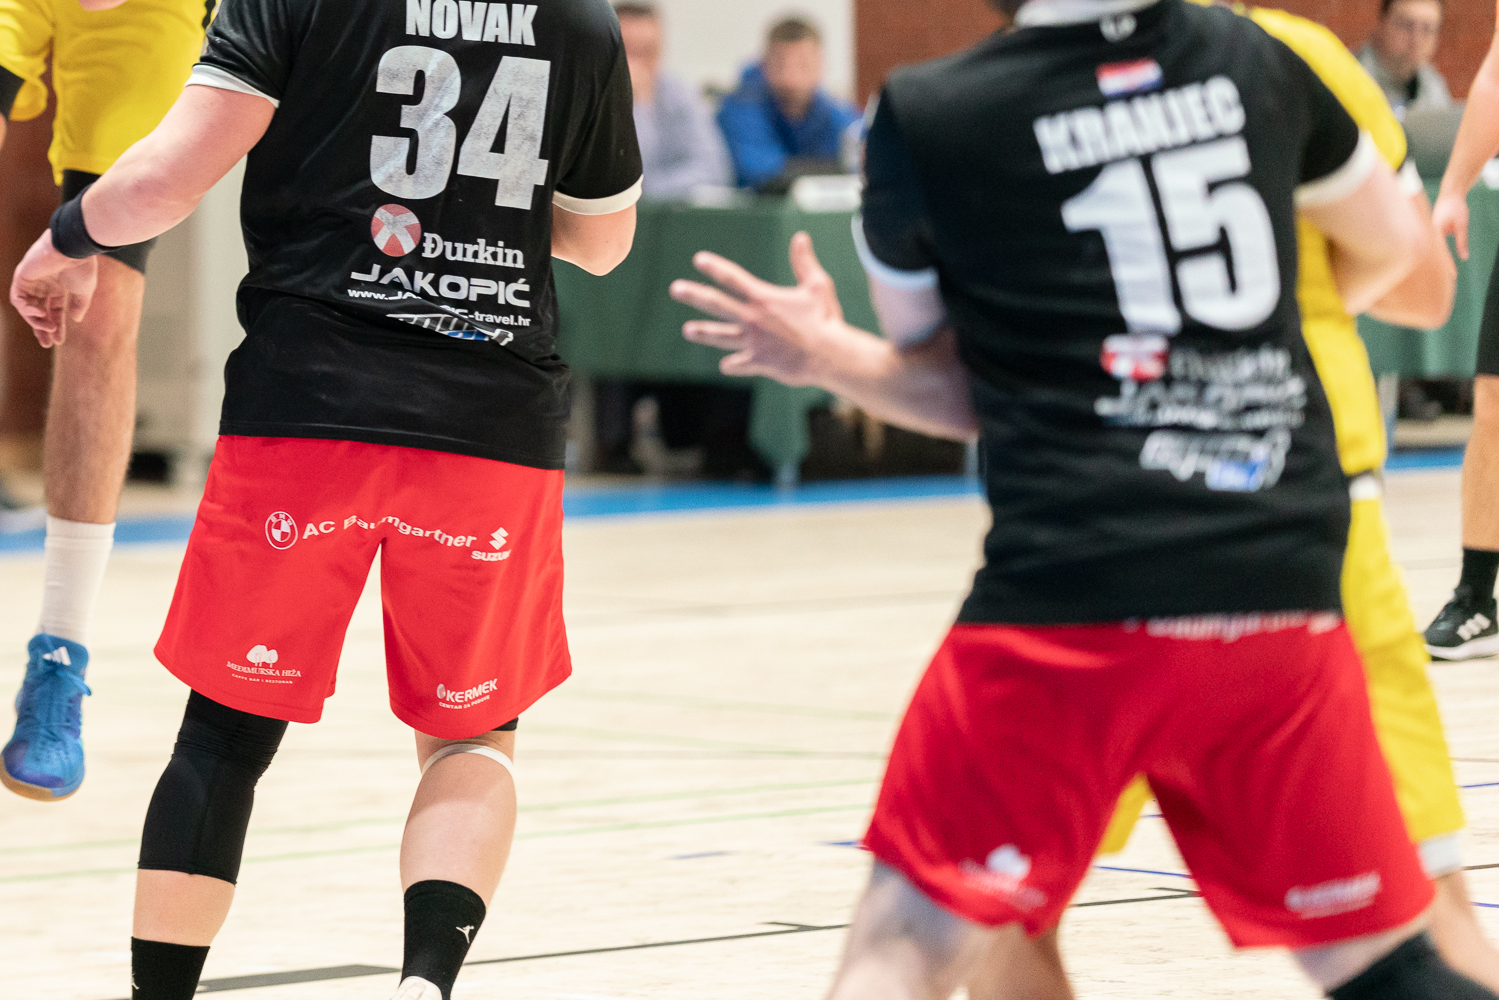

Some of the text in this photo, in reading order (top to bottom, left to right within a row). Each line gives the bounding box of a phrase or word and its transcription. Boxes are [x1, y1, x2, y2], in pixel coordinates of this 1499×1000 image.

[369, 44, 552, 211] 34
[1032, 73, 1248, 175] KRANJEC
[421, 231, 526, 270] Đurkin
[1059, 134, 1282, 337] 15
[349, 262, 532, 308] JAKOPIĆ
[302, 514, 478, 548] AC Baumgartner
[445, 678, 498, 703] KERMEK
